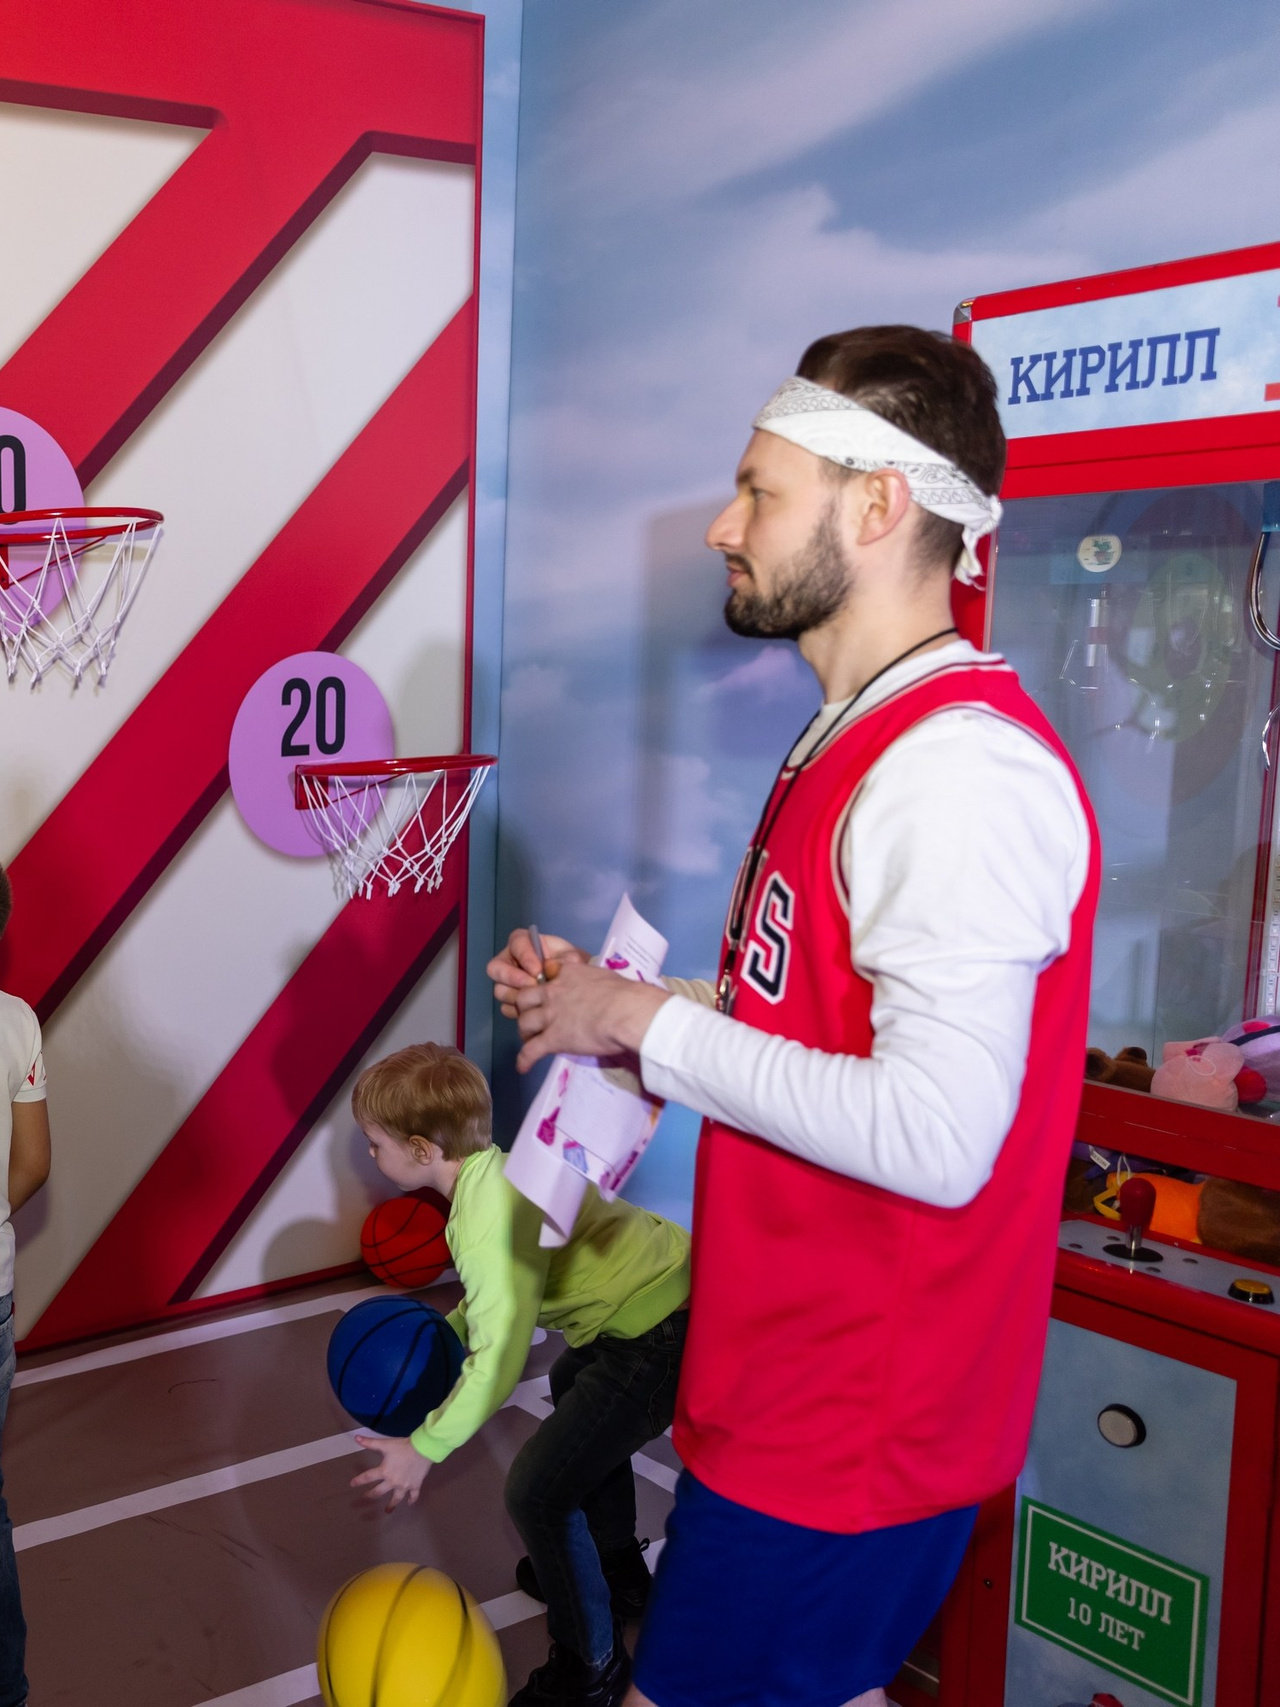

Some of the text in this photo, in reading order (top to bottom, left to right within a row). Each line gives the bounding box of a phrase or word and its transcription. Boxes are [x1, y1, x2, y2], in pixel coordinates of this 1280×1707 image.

[1007, 326, 1221, 405] КИРИЛЛ
[280, 676, 346, 758] 20
[1047, 1541, 1173, 1626] КИРИЛЛ
[1067, 1597, 1146, 1651] 10 ЛЕТ
